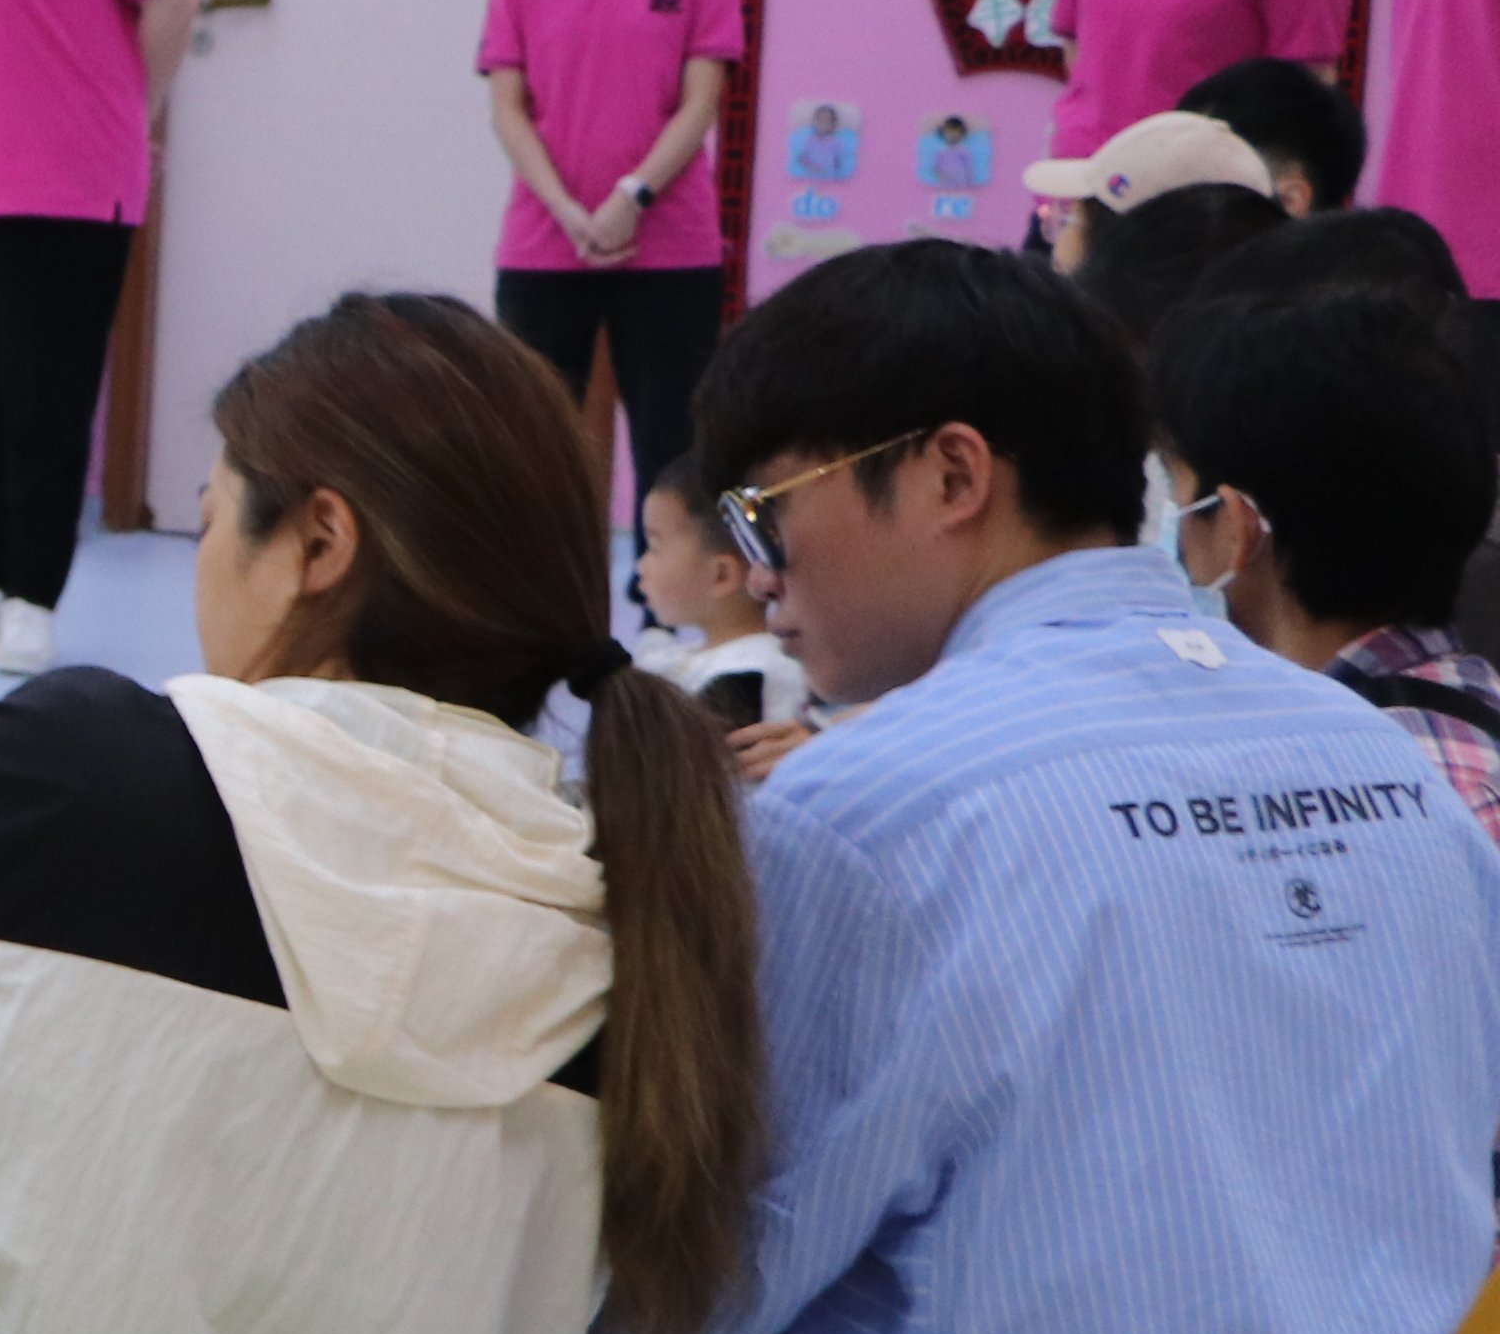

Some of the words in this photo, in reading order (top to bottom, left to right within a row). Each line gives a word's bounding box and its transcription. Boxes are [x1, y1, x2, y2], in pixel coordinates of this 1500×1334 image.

[793, 186, 838, 219] do
[935, 195, 973, 219] re
[1109, 801, 1179, 839] TO
[1187, 796, 1244, 835] BE
[1252, 782, 1428, 831] INFINITY
